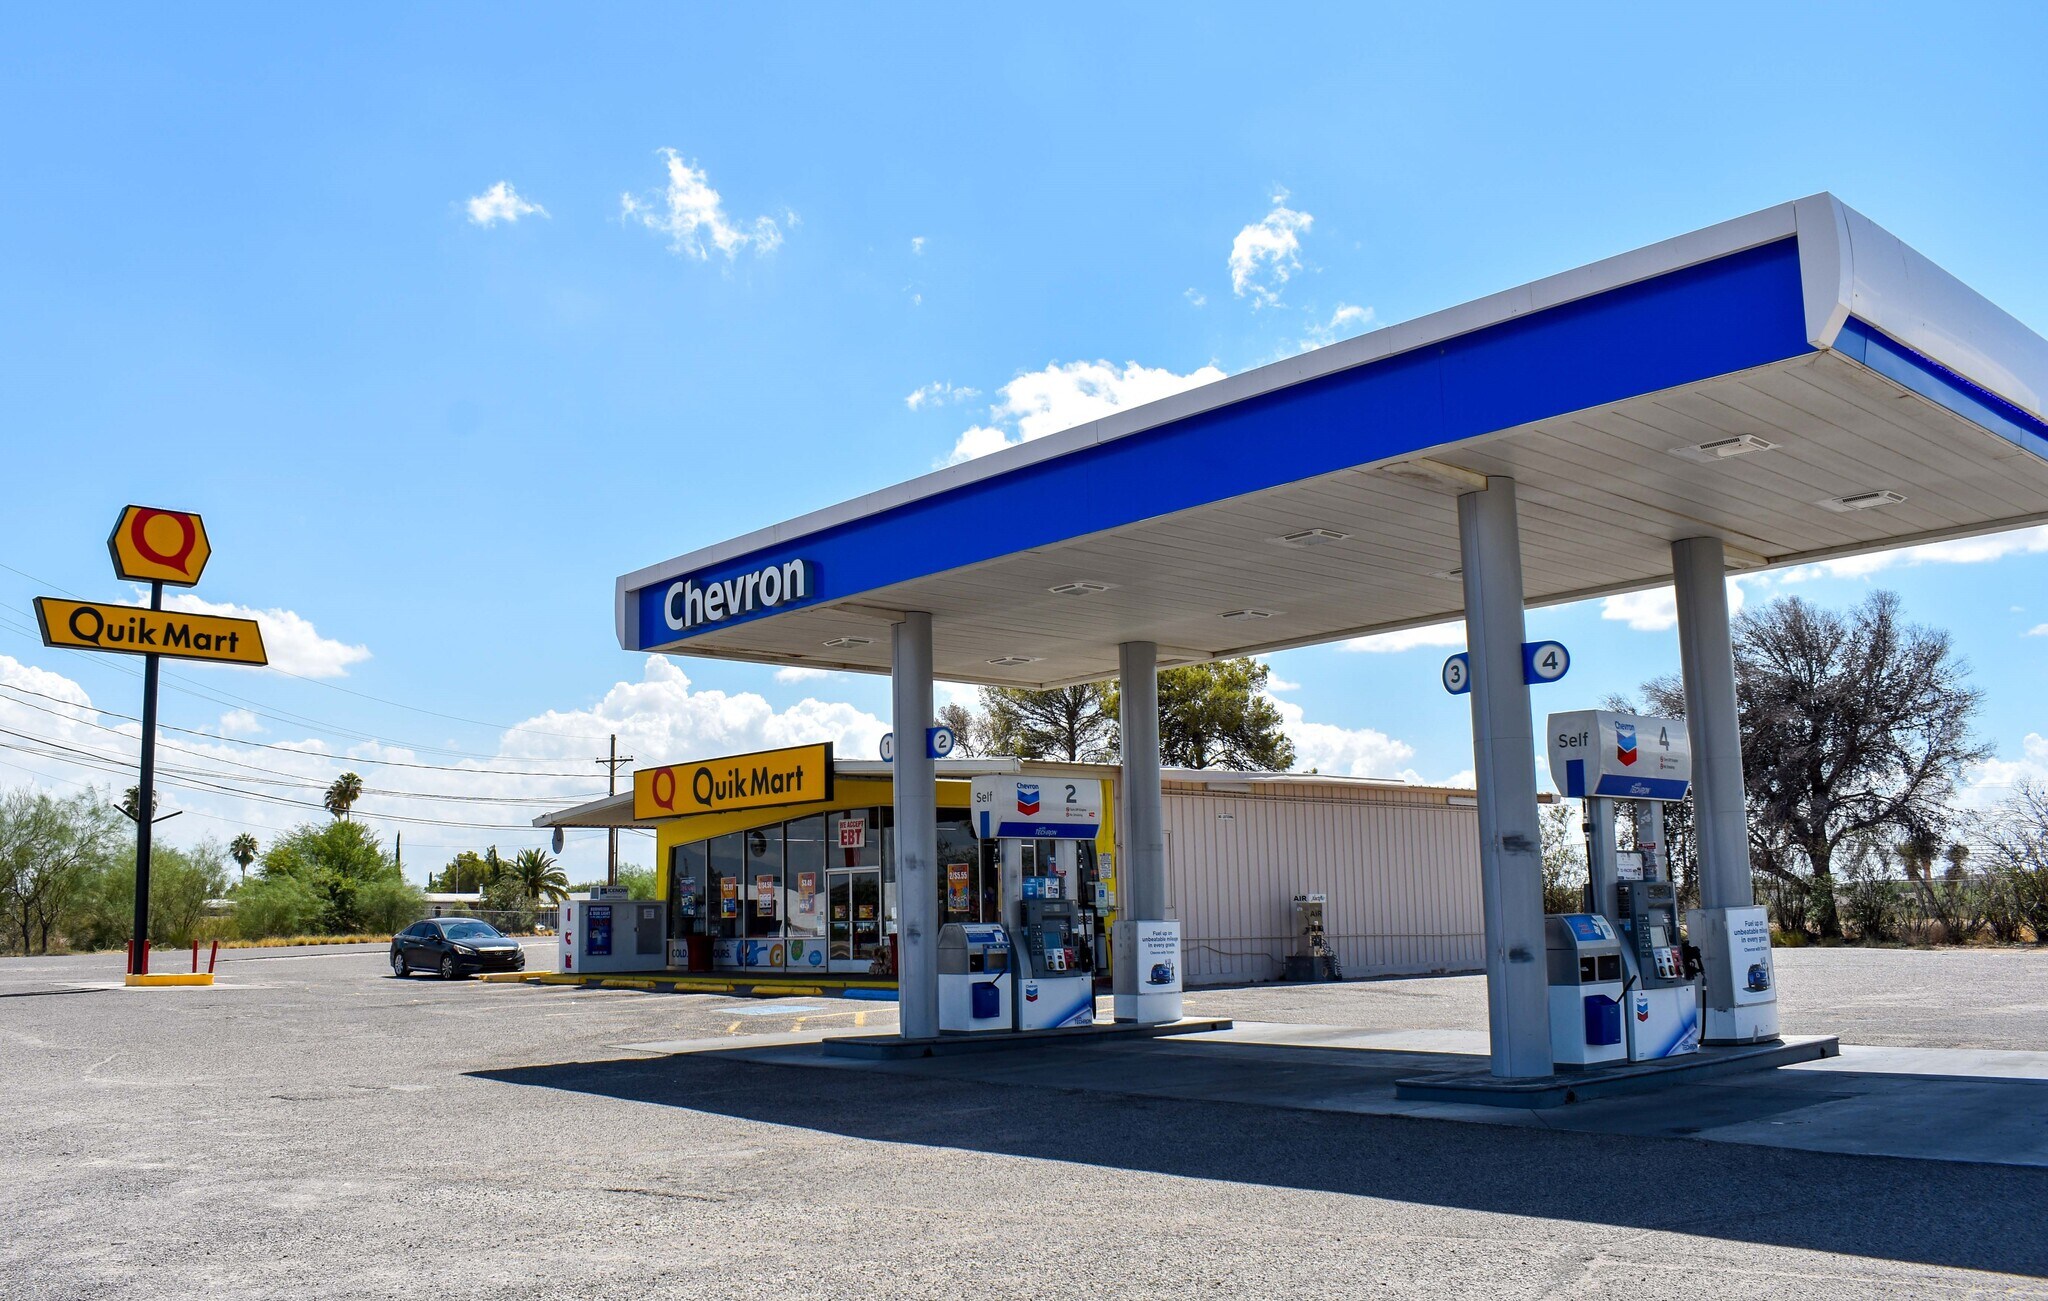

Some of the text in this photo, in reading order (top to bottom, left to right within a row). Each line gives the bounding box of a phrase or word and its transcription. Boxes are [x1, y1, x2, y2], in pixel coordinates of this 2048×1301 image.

[131, 508, 195, 577] Q
[664, 558, 805, 631] Chevron
[69, 606, 239, 653] Quik Mart
[1542, 651, 1559, 670] 4
[1450, 665, 1461, 684] 3
[1614, 721, 1635, 731] Chevron
[886, 741, 890, 754] 1
[938, 734, 947, 749] 2
[1558, 731, 1589, 748] Self
[1659, 726, 1670, 751] 4
[652, 766, 676, 813] Q
[692, 765, 803, 808] Quik Mart
[1016, 782, 1040, 790] Chevron
[1065, 784, 1077, 804] 2
[976, 791, 993, 803] Self
[841, 829, 862, 845] EBT
